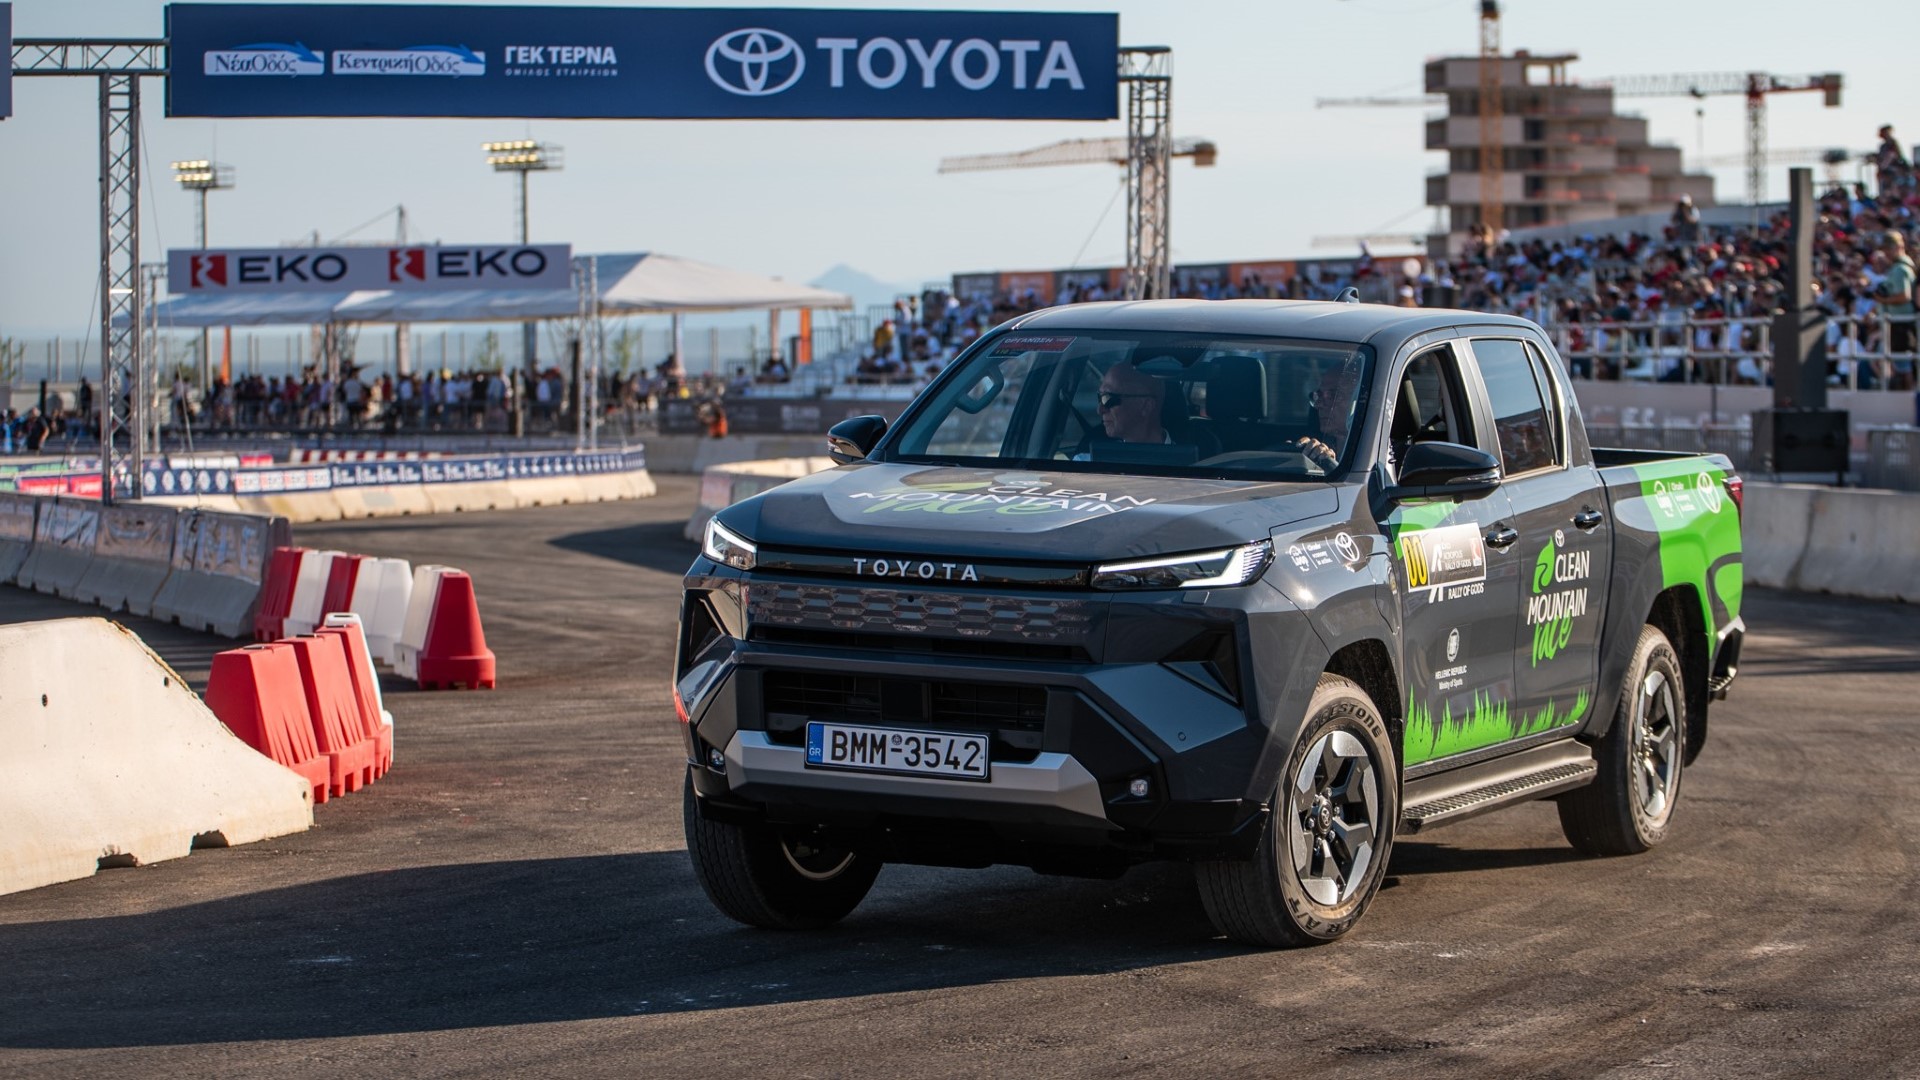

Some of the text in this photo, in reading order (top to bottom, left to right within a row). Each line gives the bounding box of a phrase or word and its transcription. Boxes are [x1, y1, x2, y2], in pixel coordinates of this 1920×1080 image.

[505, 46, 617, 64] ΓΕΚ ΤΕΡΝΑ
[816, 36, 1085, 91] TOYOTA
[238, 254, 348, 282] EKO
[436, 249, 547, 278] EKO
[849, 492, 1134, 514] MOUNTAIN
[988, 485, 1157, 506] CLEAN
[853, 558, 978, 581] TOYOTA
[1555, 550, 1590, 582] CLEAN
[1448, 582, 1484, 600] RALLY OF GODS
[1527, 587, 1587, 625] MOUNTAIN
[809, 747, 821, 757] GR
